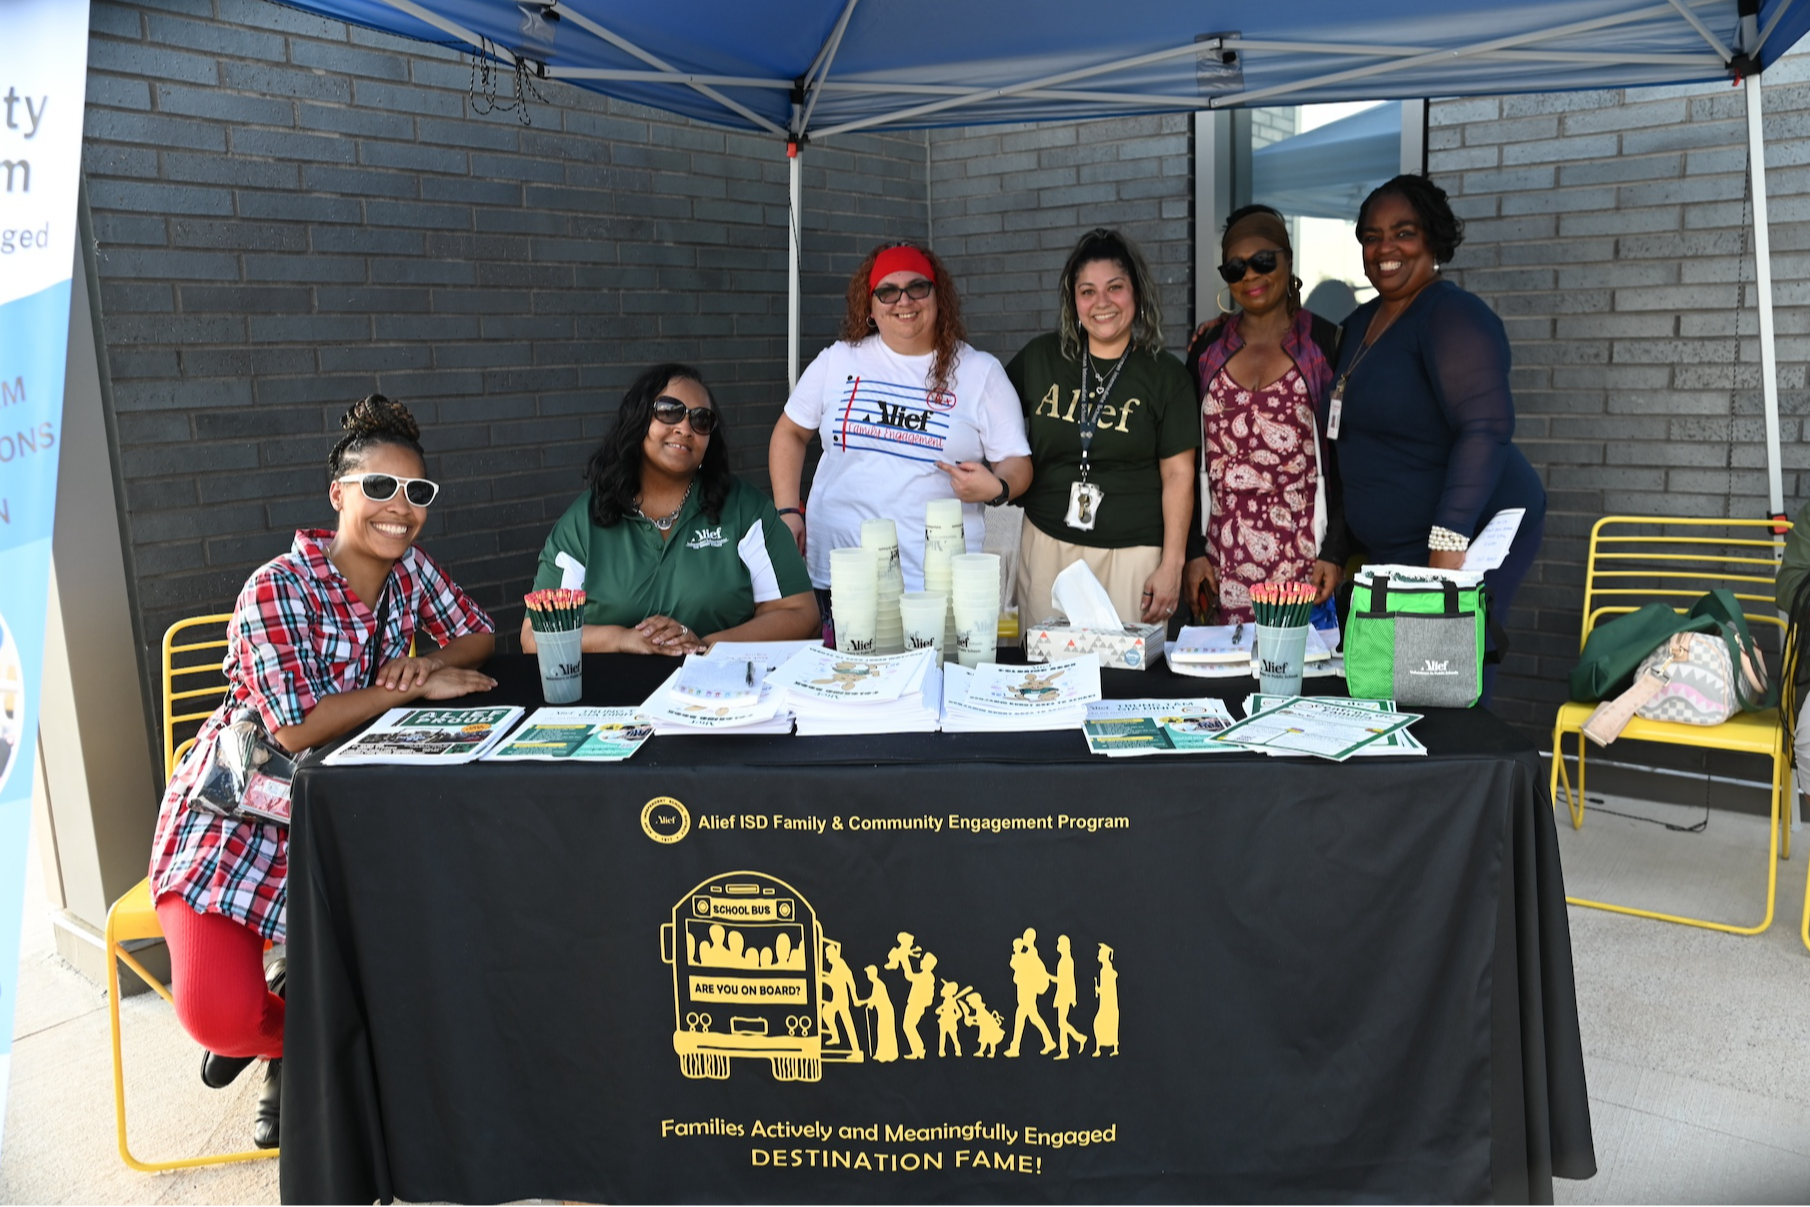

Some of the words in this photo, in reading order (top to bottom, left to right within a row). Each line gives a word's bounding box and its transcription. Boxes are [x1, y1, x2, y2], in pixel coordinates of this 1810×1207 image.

[0, 375, 26, 407] M
[863, 400, 934, 432] Alief
[848, 422, 882, 438] Family
[884, 427, 944, 448] Engagement
[691, 526, 722, 542] Alief
[848, 638, 873, 651] Alief
[909, 637, 934, 648] Alief
[556, 661, 581, 676] Alief
[1261, 659, 1288, 674] Alief
[1420, 660, 1449, 671] Alief
[656, 815, 676, 824] Alief
[698, 815, 735, 829] Alief
[741, 815, 768, 829] ISD
[774, 815, 826, 833] Family
[832, 816, 843, 830] &
[849, 815, 943, 832] Community
[949, 815, 1053, 832] Engagement
[1059, 815, 1130, 831] Program
[713, 905, 750, 915] SCHOOL
[752, 906, 771, 915] BUS
[695, 983, 714, 994] ARE
[717, 984, 738, 995] YOU
[741, 986, 757, 995] ON
[760, 986, 800, 996] BOARD?
[662, 1119, 744, 1138] Families
[751, 1120, 832, 1141] Actively
[839, 1122, 878, 1141] and
[885, 1121, 1018, 1146] Meaningfully
[1025, 1124, 1117, 1148] Engaged
[751, 1149, 943, 1172] DESTINATION
[955, 1150, 1042, 1174] FAME!
